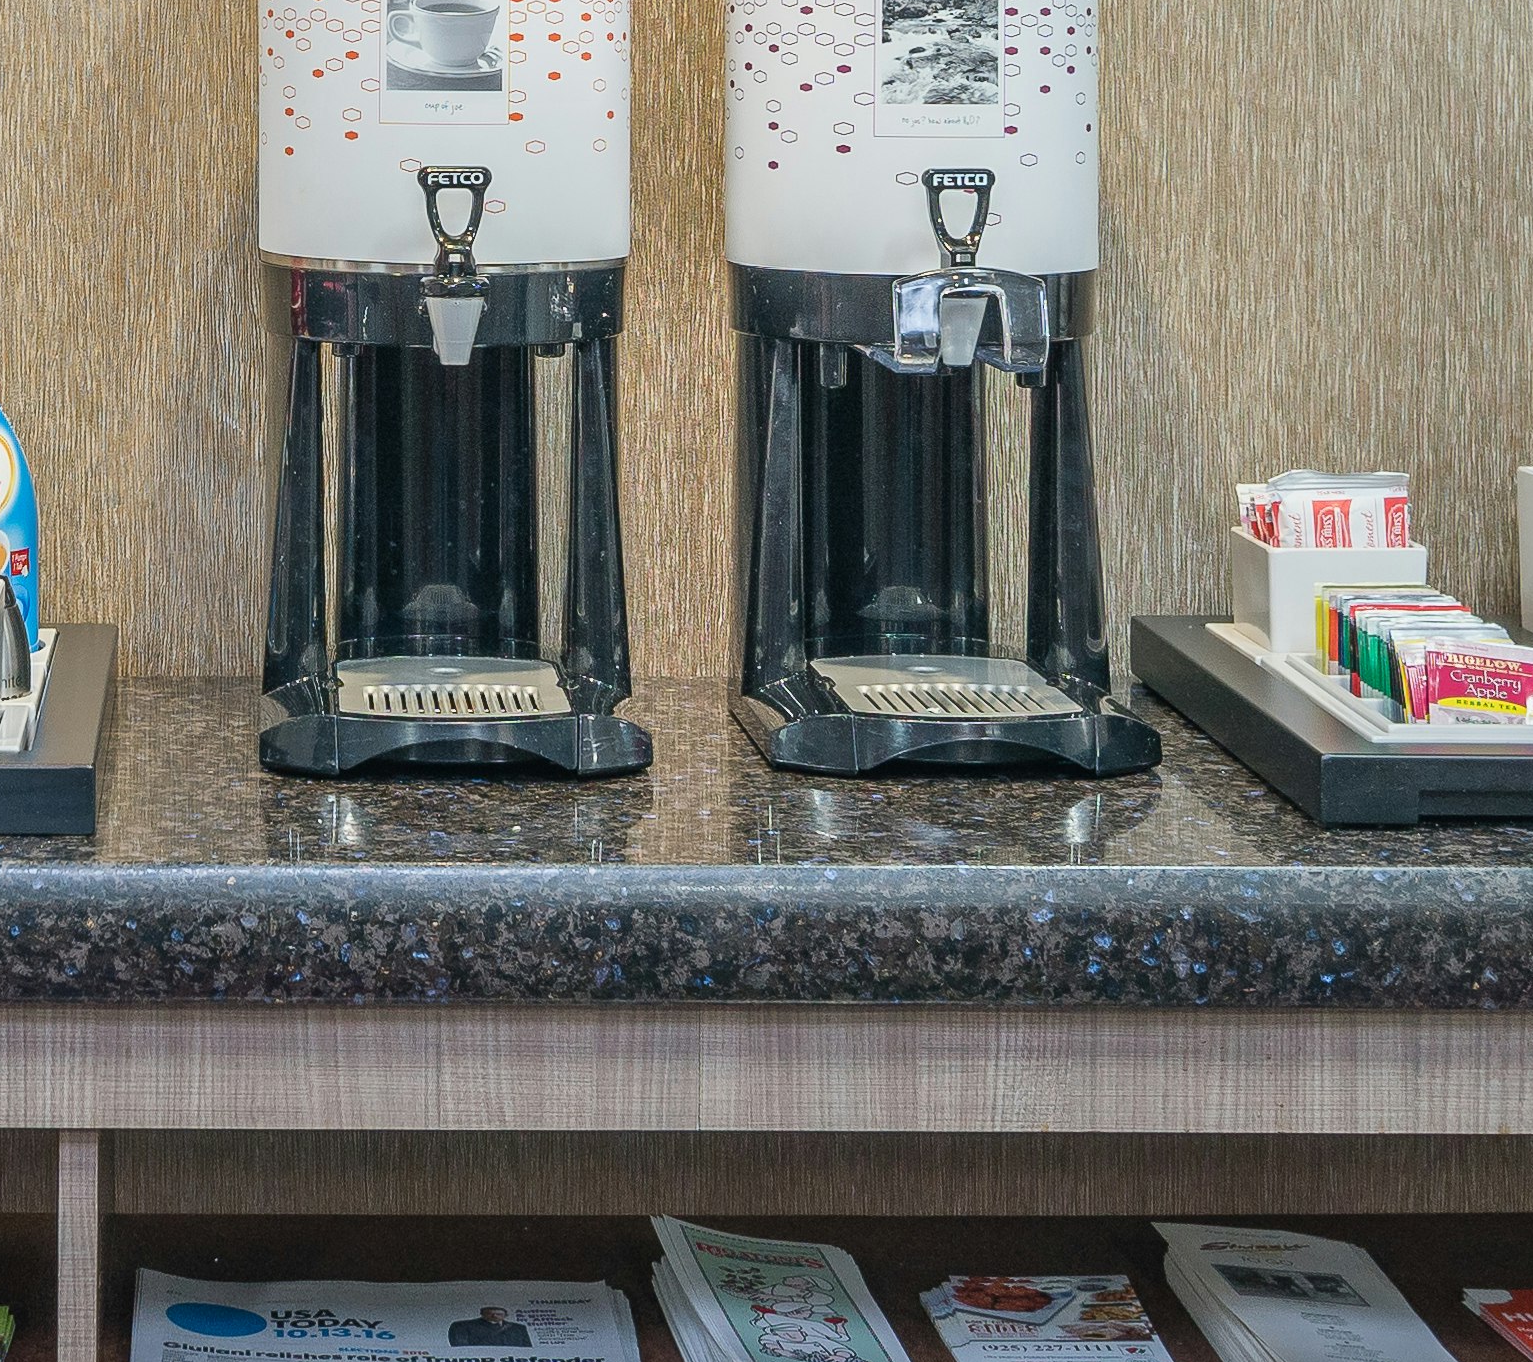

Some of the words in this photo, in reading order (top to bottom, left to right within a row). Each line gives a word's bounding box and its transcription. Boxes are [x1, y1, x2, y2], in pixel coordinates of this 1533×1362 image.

[427, 172, 484, 185] FETCO
[932, 173, 988, 186] FETCO
[1450, 671, 1521, 694] Cranberry
[1465, 684, 1508, 699] Apple
[1456, 699, 1495, 708] HERBAL
[270, 1309, 337, 1319] USA
[270, 1319, 384, 1329] TODAY
[274, 1328, 396, 1340] 10.13.16
[163, 1341, 251, 1356] Giuliani
[256, 1350, 342, 1360] relishes
[347, 1354, 391, 1362] role
